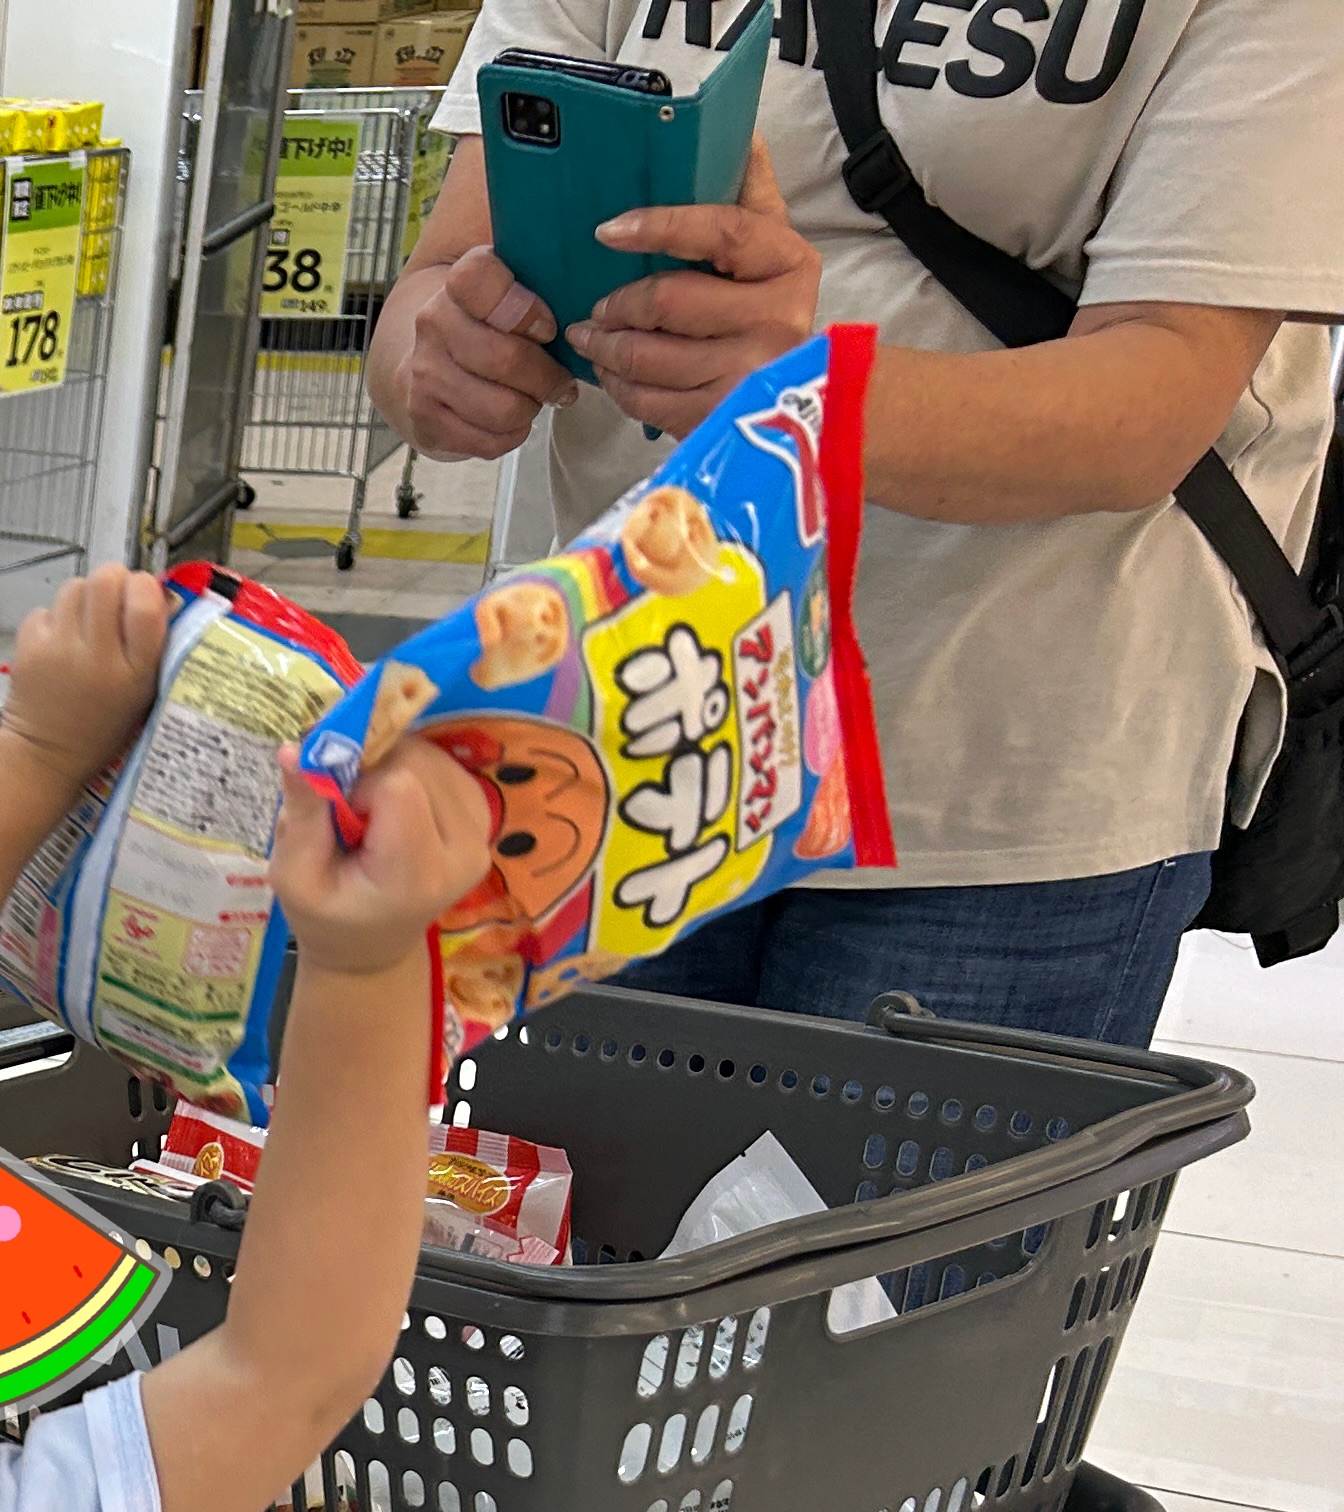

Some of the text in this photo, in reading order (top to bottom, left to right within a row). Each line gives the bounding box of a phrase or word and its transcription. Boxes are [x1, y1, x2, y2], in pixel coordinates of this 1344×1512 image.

[5, 310, 60, 368] 178
[613, 621, 732, 929] ポテト
[739, 621, 781, 836] アンパンマン
